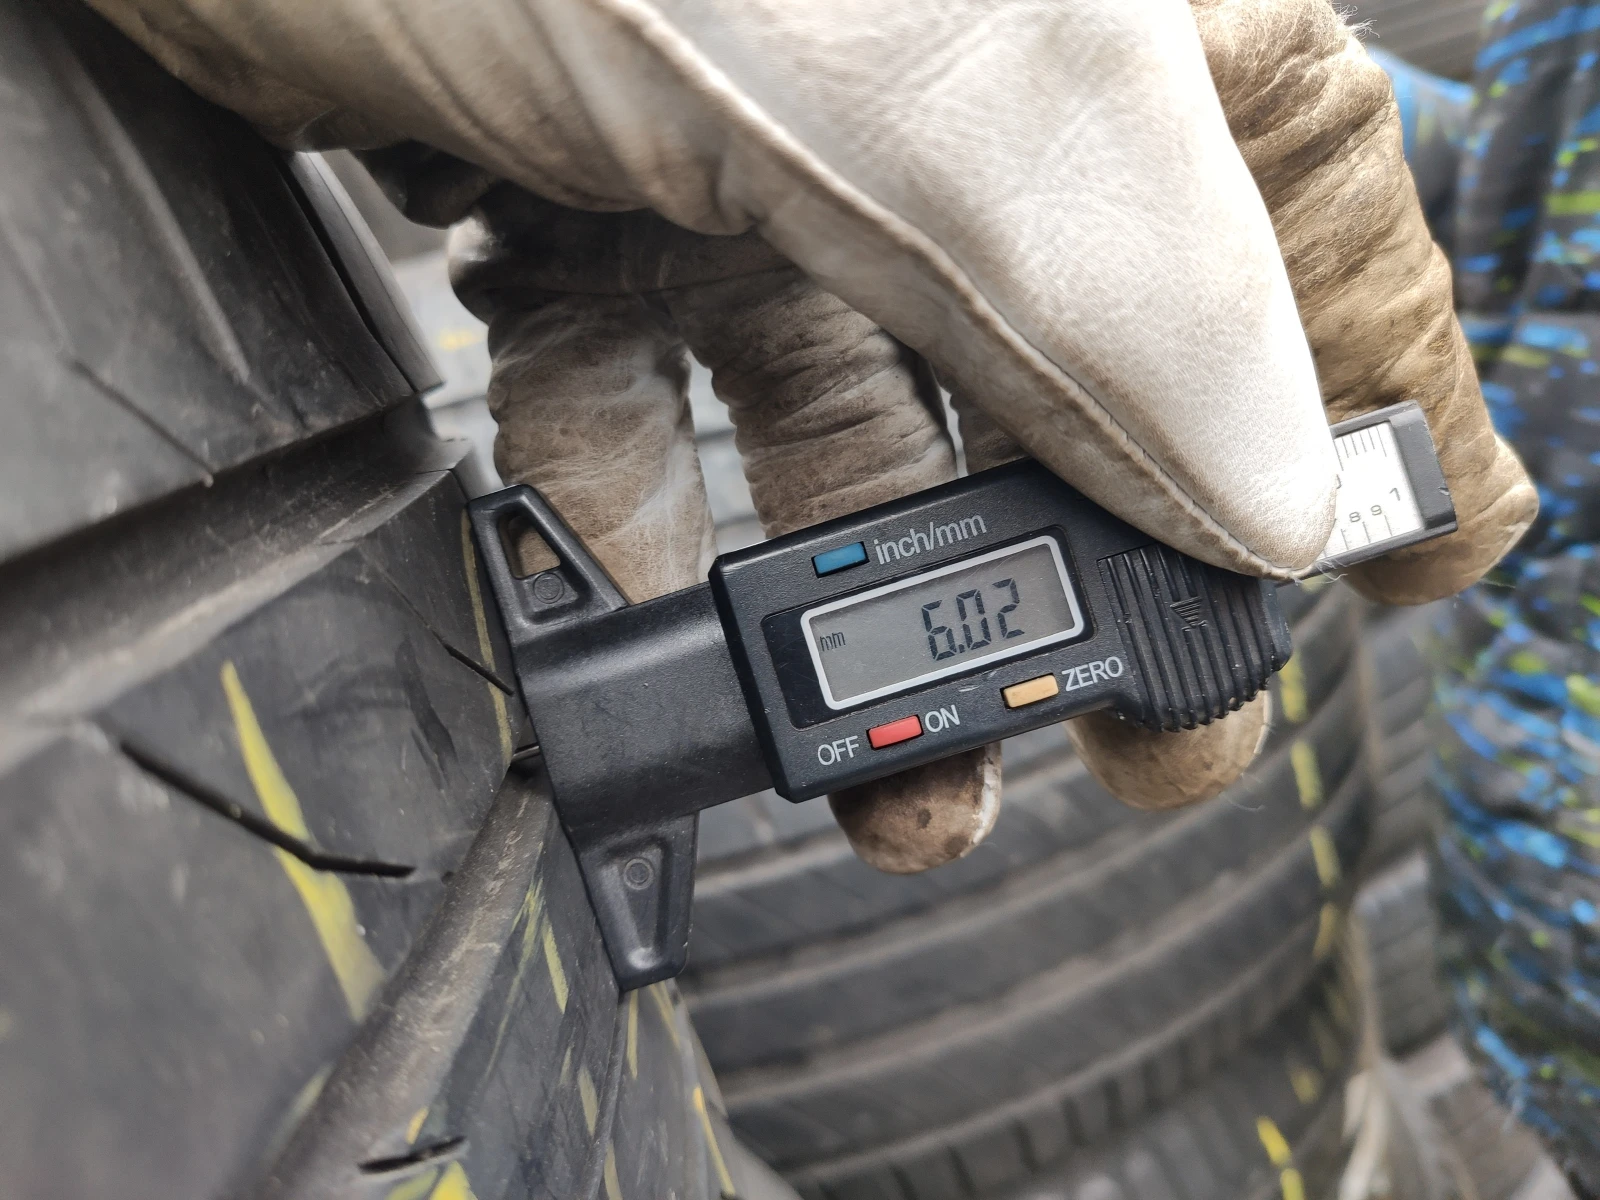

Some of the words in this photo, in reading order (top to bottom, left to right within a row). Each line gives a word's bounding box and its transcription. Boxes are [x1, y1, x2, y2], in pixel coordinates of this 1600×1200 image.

[1349, 511, 1361, 522] 8
[1370, 504, 1382, 516] 9
[1389, 487, 1400, 501] 1
[874, 513, 987, 565] inch/mm
[820, 631, 846, 652] mm
[921, 578, 1025, 661] 6.02
[1061, 656, 1123, 692] ZERO
[817, 735, 859, 766] OFF
[924, 704, 961, 734] ON
